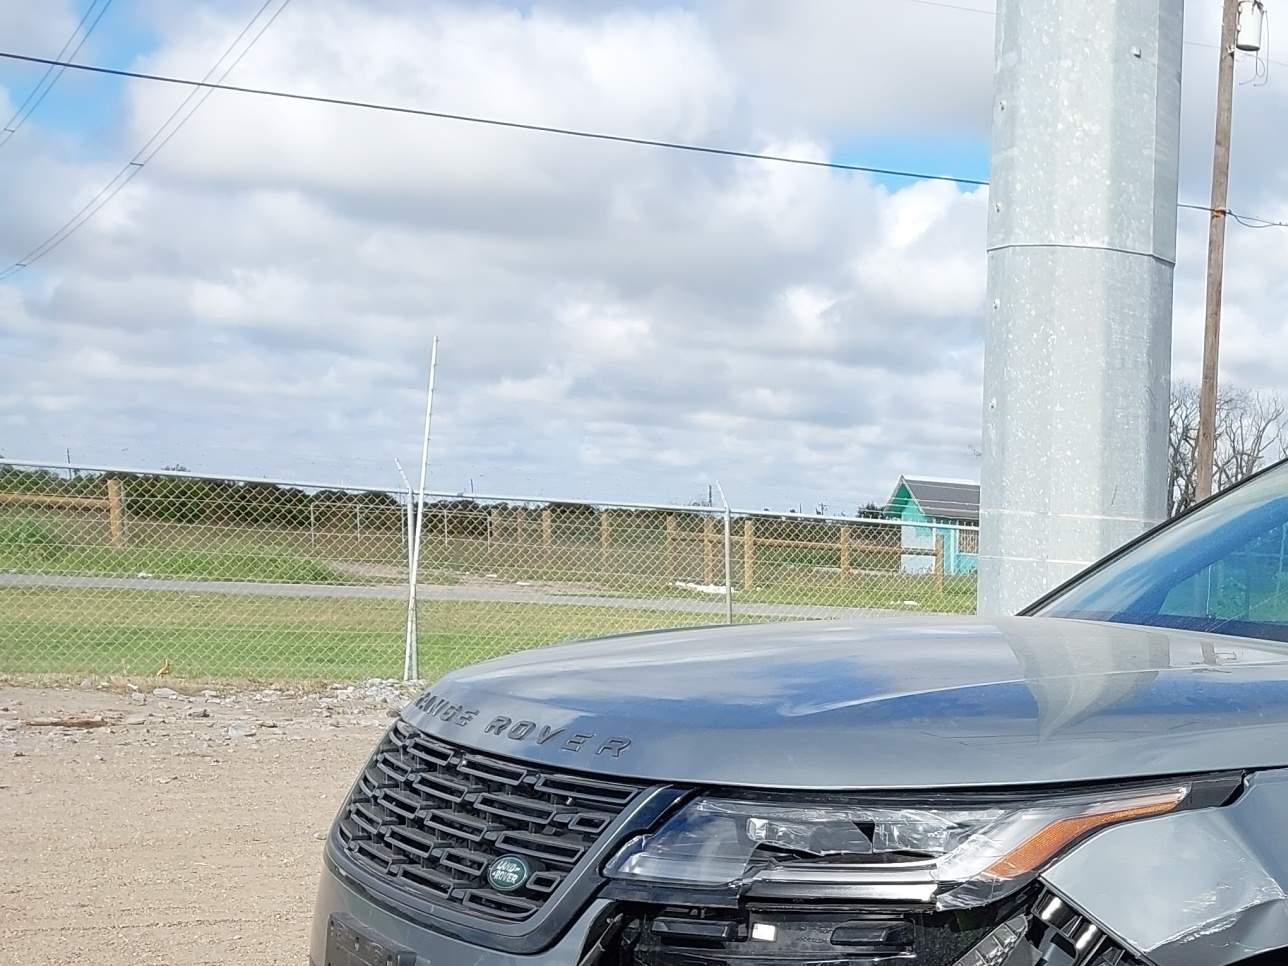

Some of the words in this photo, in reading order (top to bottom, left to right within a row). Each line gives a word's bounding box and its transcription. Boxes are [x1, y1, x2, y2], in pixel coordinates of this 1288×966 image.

[415, 691, 480, 727] ANGE
[484, 715, 632, 758] ROVER
[493, 870, 519, 884] ROVER
